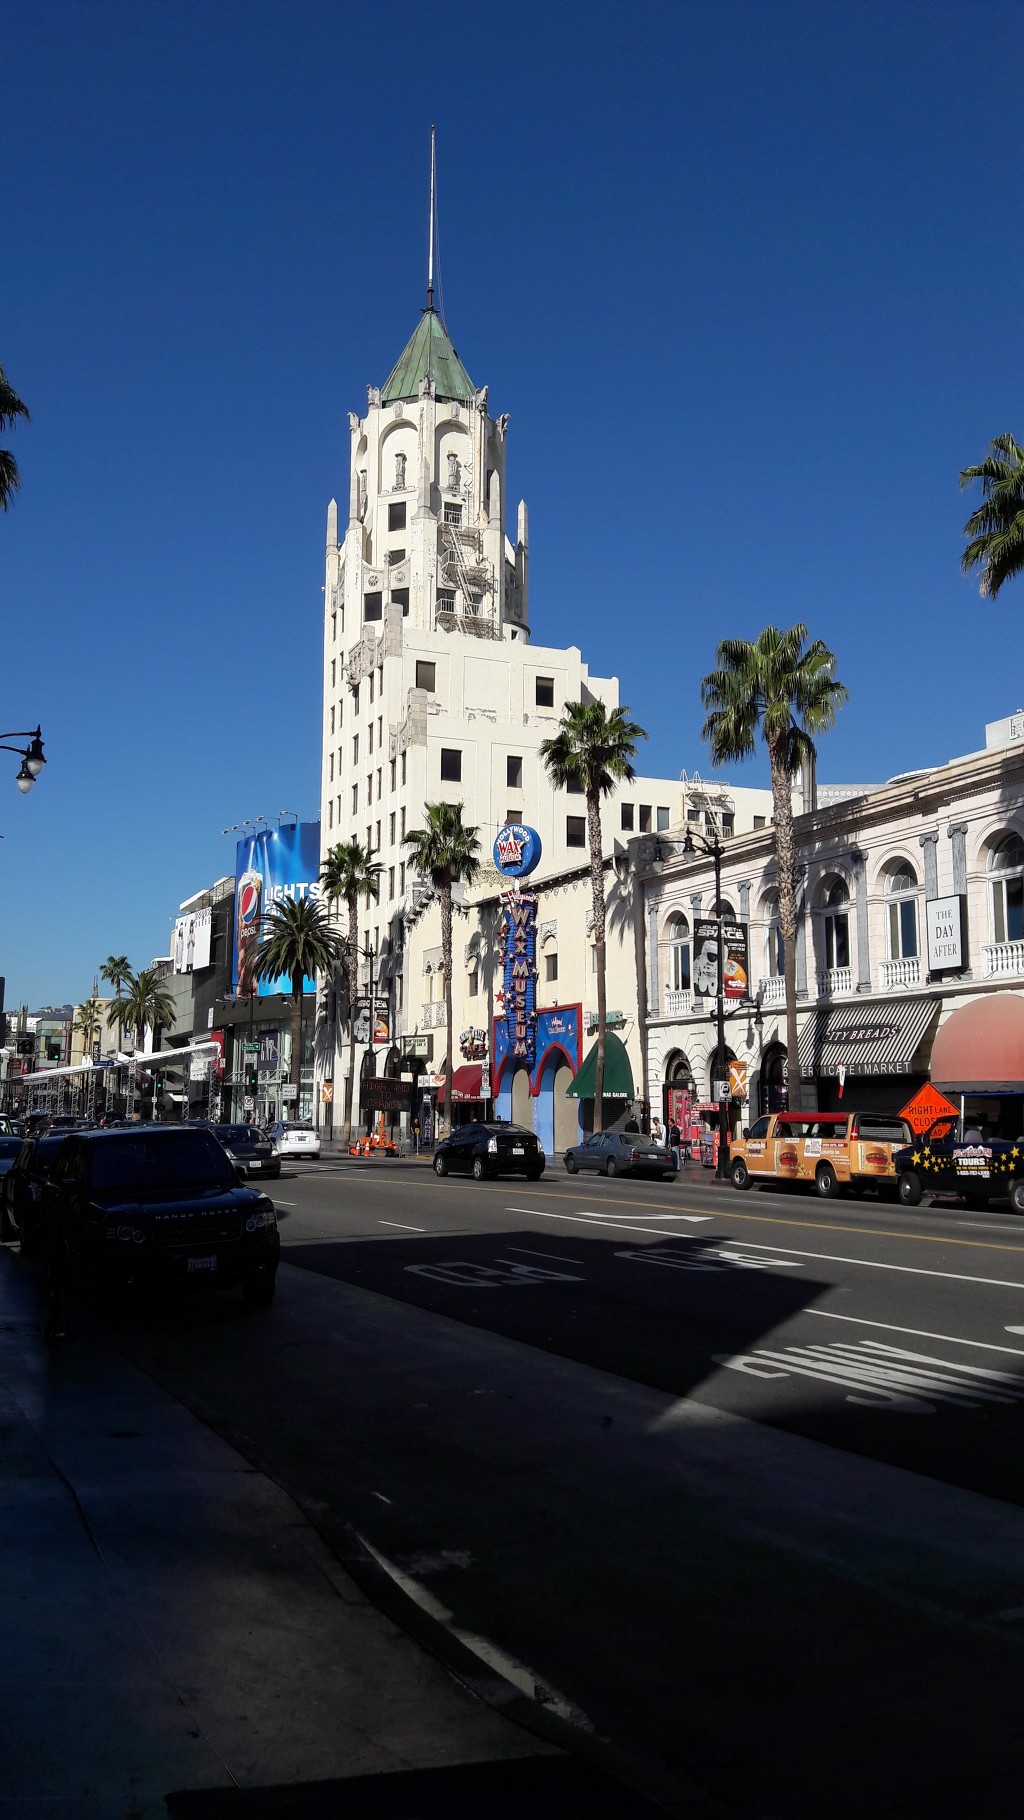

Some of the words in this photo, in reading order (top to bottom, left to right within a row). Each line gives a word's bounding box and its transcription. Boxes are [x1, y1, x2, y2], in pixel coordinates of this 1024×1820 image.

[497, 826, 530, 845] HOLLYWOOD
[500, 841, 519, 855] WAX
[264, 882, 321, 904] LIGHTS
[935, 909, 953, 920] THE
[240, 926, 257, 940] pepsi
[511, 906, 530, 956] WAX
[697, 928, 745, 940] SPACE
[935, 924, 954, 939] DAY
[933, 943, 957, 958] AFTER
[512, 959, 529, 1057] MUSEUM
[822, 1032, 850, 1041] CITY
[850, 1026, 899, 1040] BREADS
[459, 1044, 485, 1053] CAFE
[782, 1066, 820, 1077] BERY
[864, 1062, 910, 1074] MARKET
[362, 1081, 410, 1093] HIGHAND
[380, 1091, 392, 1100] TO
[367, 1098, 402, 1109] ORANGE
[908, 1106, 933, 1115] RIGHT
[934, 1106, 952, 1114] LANE
[958, 1158, 985, 1166] TOURS
[155, 1212, 194, 1220] RANGE
[201, 1208, 239, 1216] ROVER
